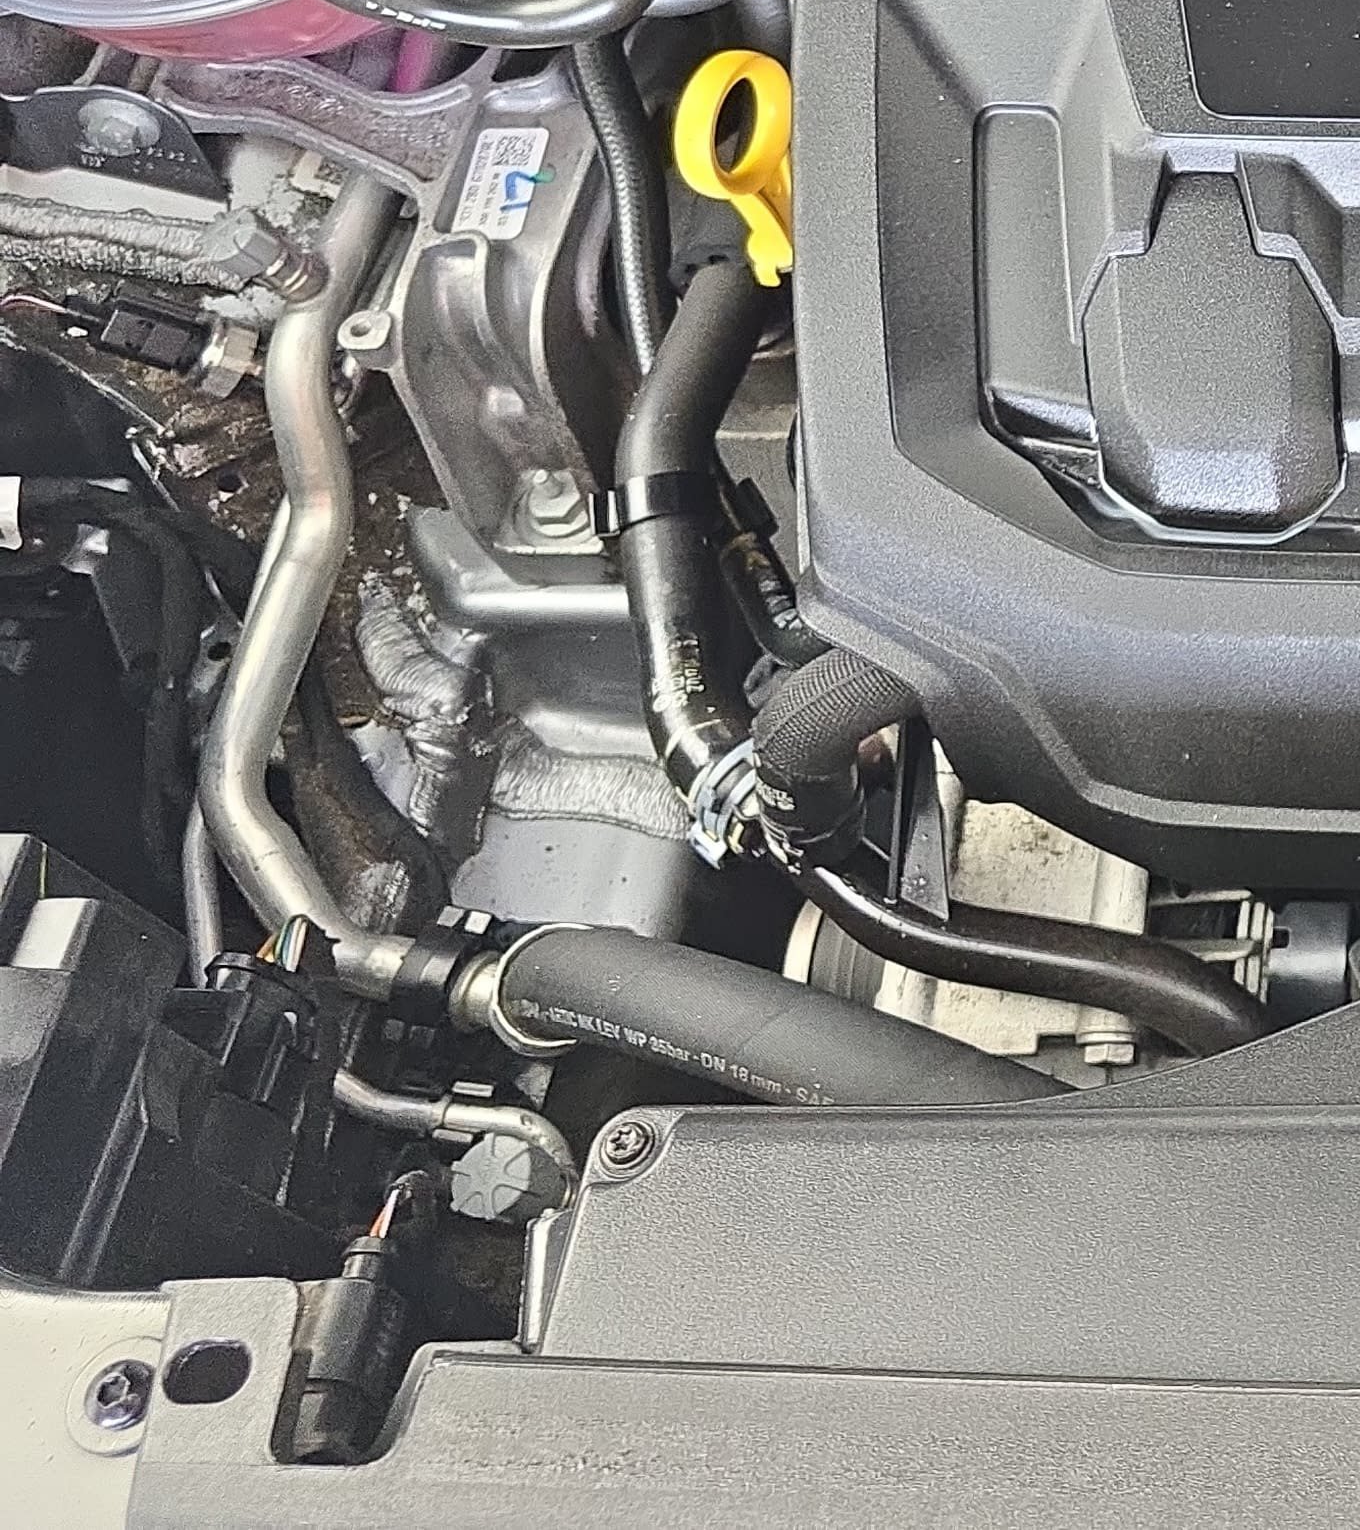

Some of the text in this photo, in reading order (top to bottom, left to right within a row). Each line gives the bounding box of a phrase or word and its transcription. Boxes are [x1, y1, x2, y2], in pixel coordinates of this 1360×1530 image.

[700, 1052, 726, 1072] DN
[730, 1064, 750, 1082] 18
[751, 1074, 782, 1094] mm
